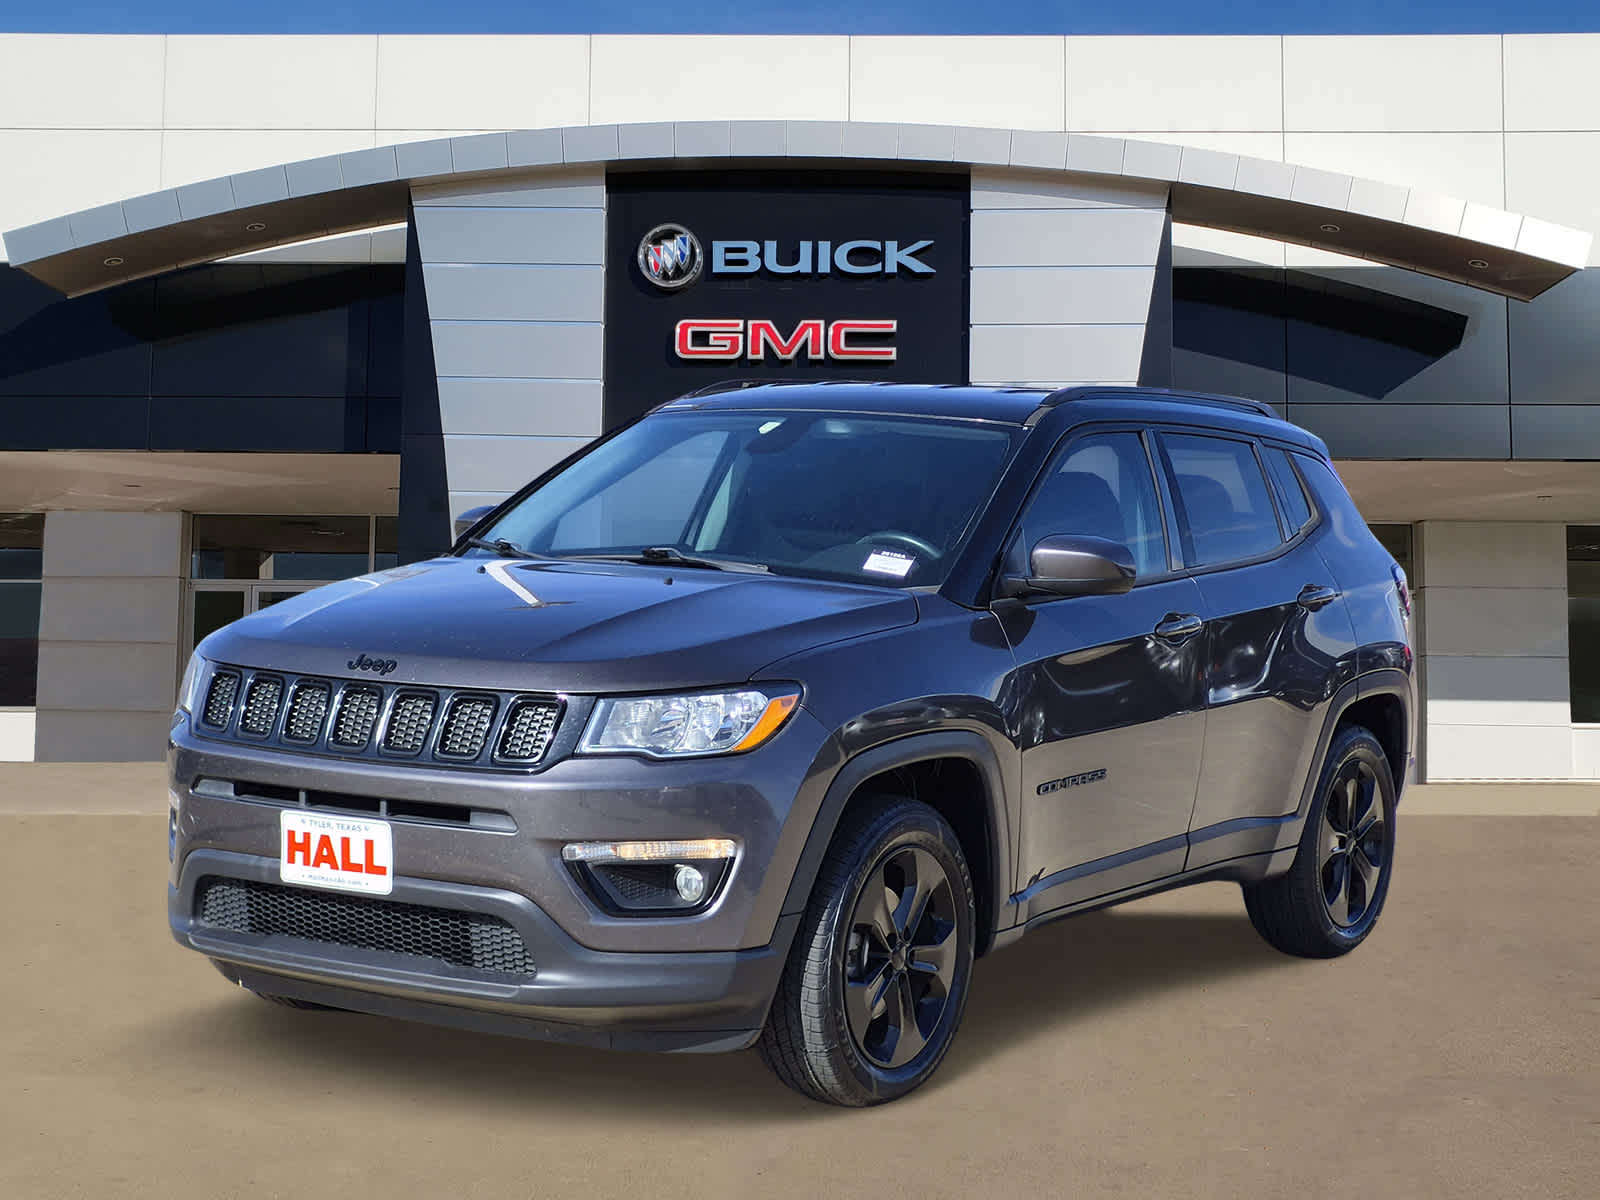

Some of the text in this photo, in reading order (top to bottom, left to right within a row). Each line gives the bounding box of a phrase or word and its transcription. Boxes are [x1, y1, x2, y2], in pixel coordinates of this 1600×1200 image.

[712, 240, 937, 274] BUICK
[675, 319, 898, 361] GMC
[347, 653, 398, 676] Jeep
[1036, 768, 1107, 796] COMPASS
[335, 822, 362, 832] TEXAS
[287, 829, 388, 876] HALL
